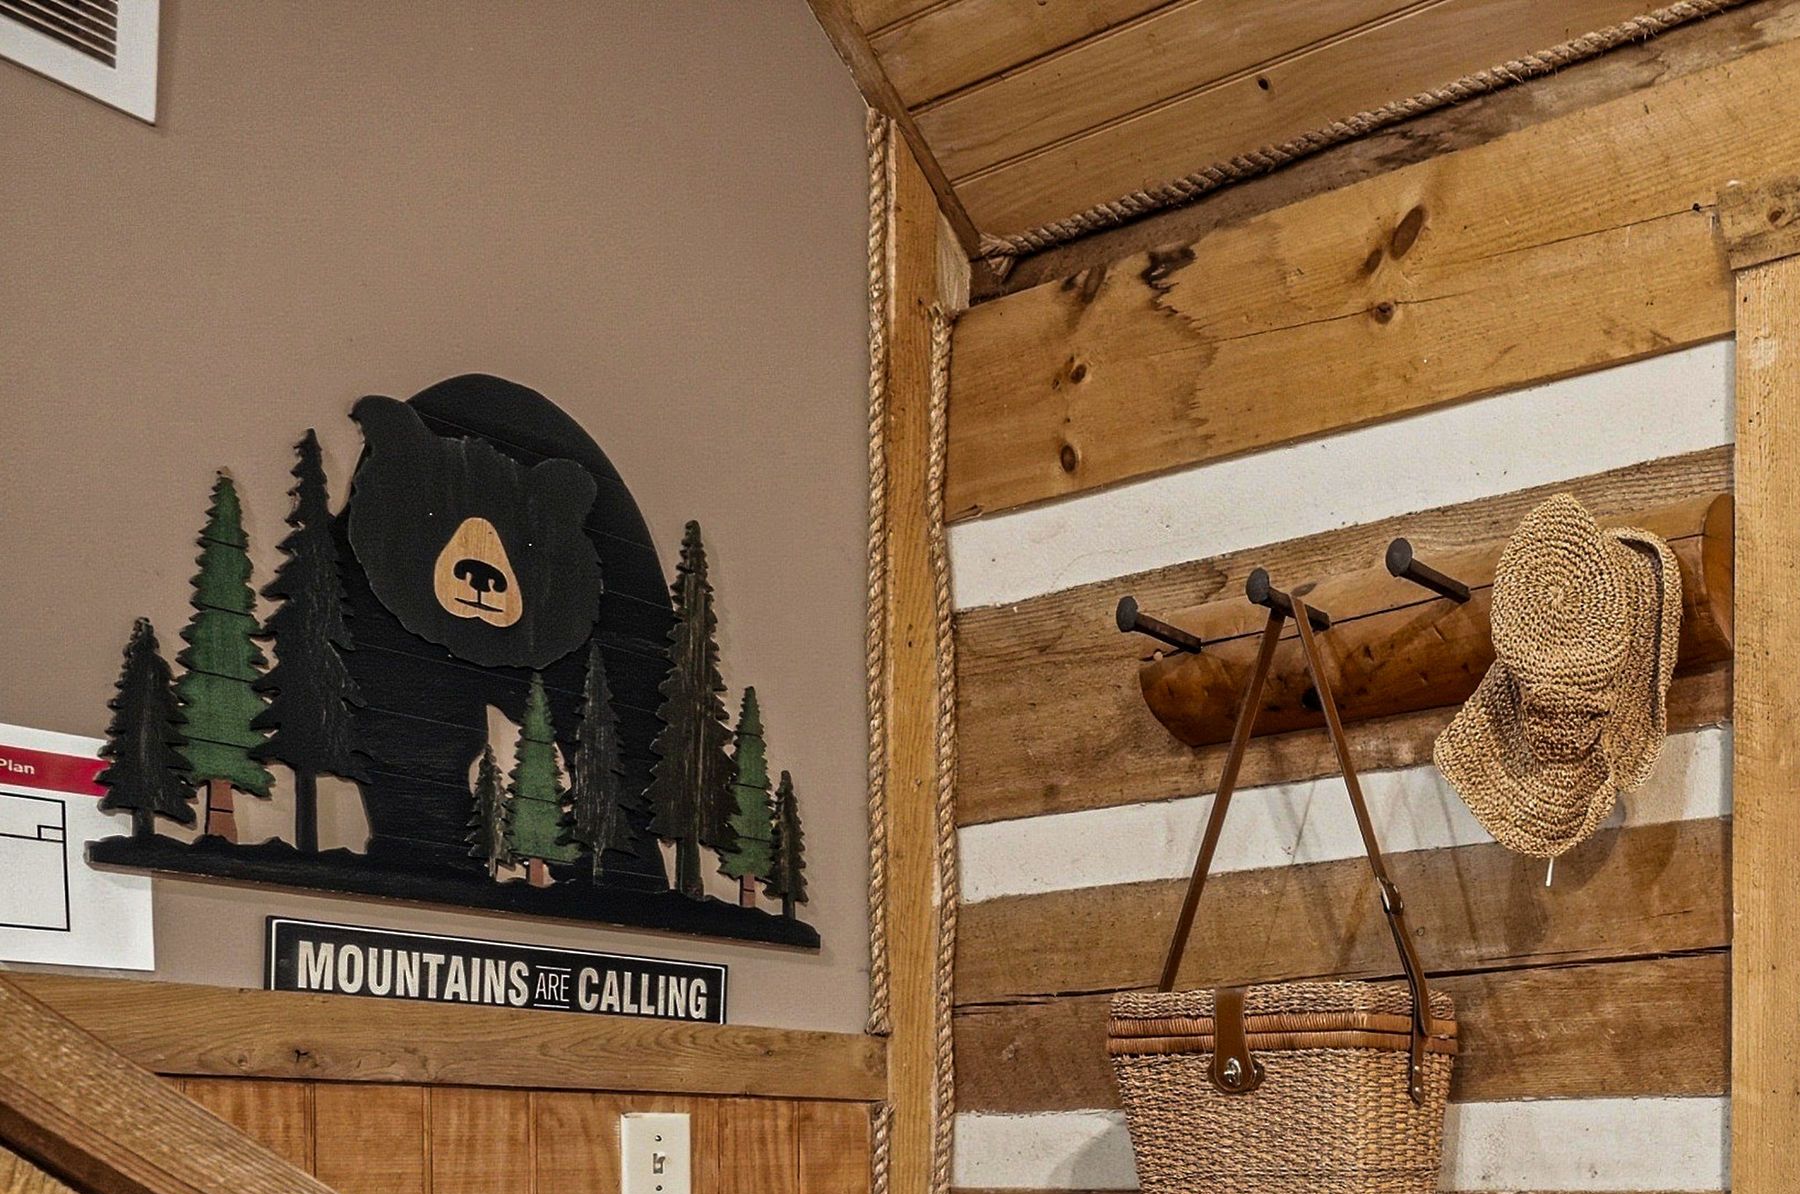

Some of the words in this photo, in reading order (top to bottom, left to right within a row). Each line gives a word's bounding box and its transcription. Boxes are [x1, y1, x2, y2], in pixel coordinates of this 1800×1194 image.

[297, 939, 529, 1007] MOUNTAINS
[535, 973, 570, 1002] ARE
[577, 966, 708, 1020] CALLING
